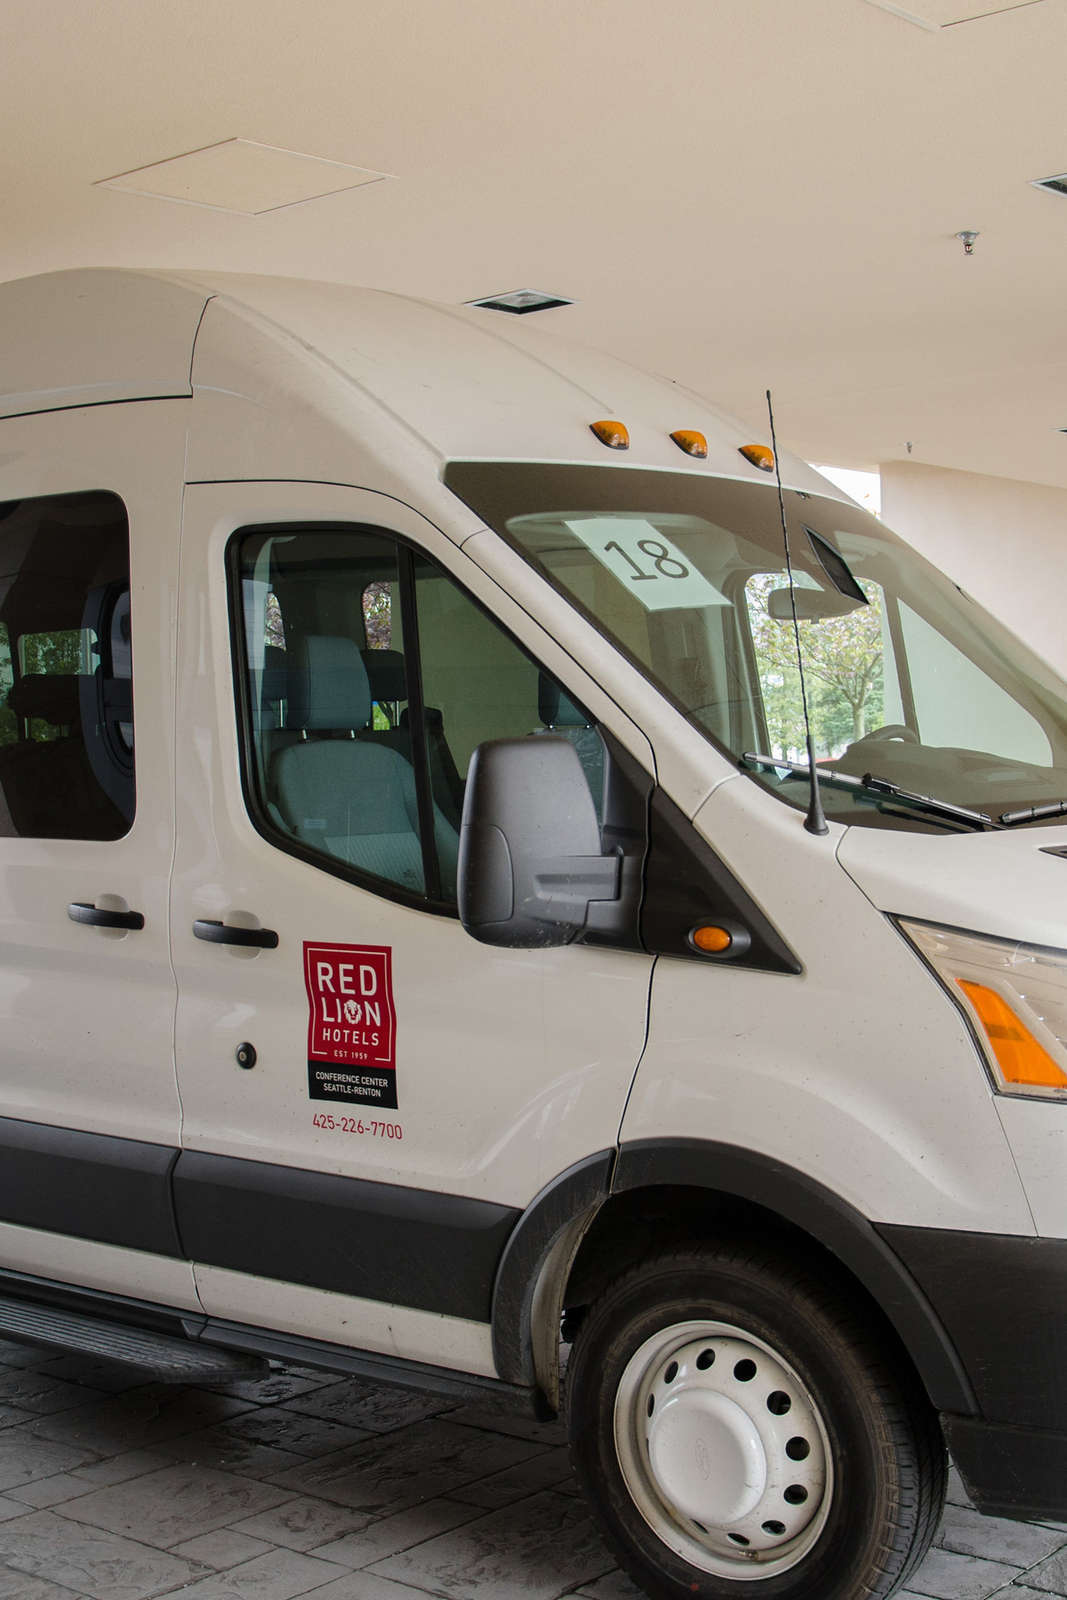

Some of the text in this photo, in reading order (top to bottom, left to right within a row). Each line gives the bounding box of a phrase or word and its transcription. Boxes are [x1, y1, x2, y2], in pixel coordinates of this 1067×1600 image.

[604, 540, 689, 580] 18
[317, 962, 377, 996] RED
[322, 1028, 379, 1046] HOTELS
[334, 1050, 348, 1058] EST
[316, 1072, 388, 1088] CONFERENCE CENTER
[323, 1083, 381, 1097] SEATTLE-RENTON
[313, 1114, 402, 1140] 425-226-7700
